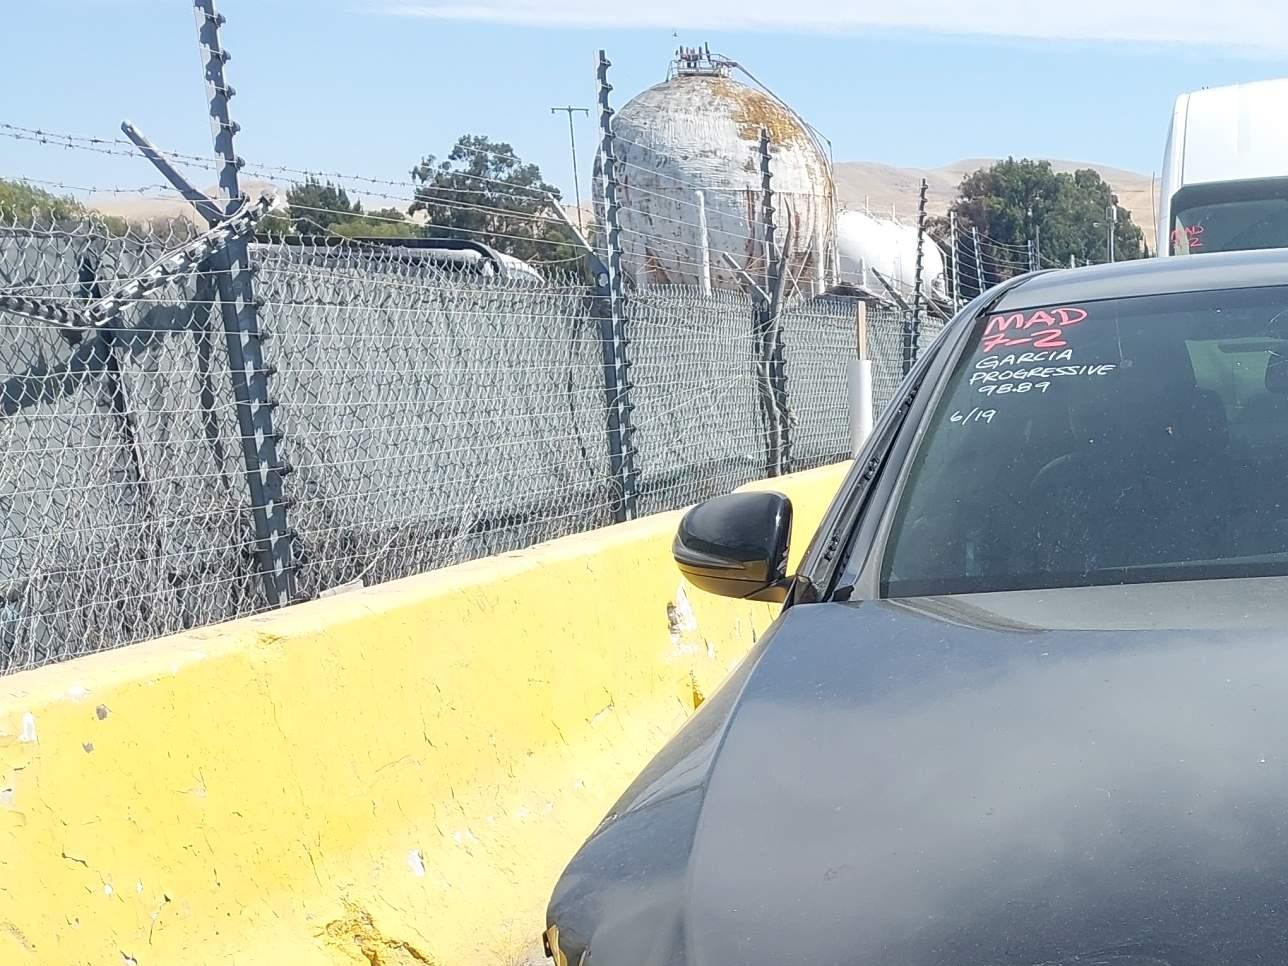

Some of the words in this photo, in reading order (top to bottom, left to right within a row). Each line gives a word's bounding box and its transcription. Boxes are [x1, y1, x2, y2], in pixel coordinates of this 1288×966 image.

[983, 307, 1088, 336] MAD
[983, 329, 1067, 352] 7-2
[975, 349, 1073, 369] GARCIA
[969, 364, 1117, 385] PROGRESSIVE
[950, 407, 997, 426] 6/19
